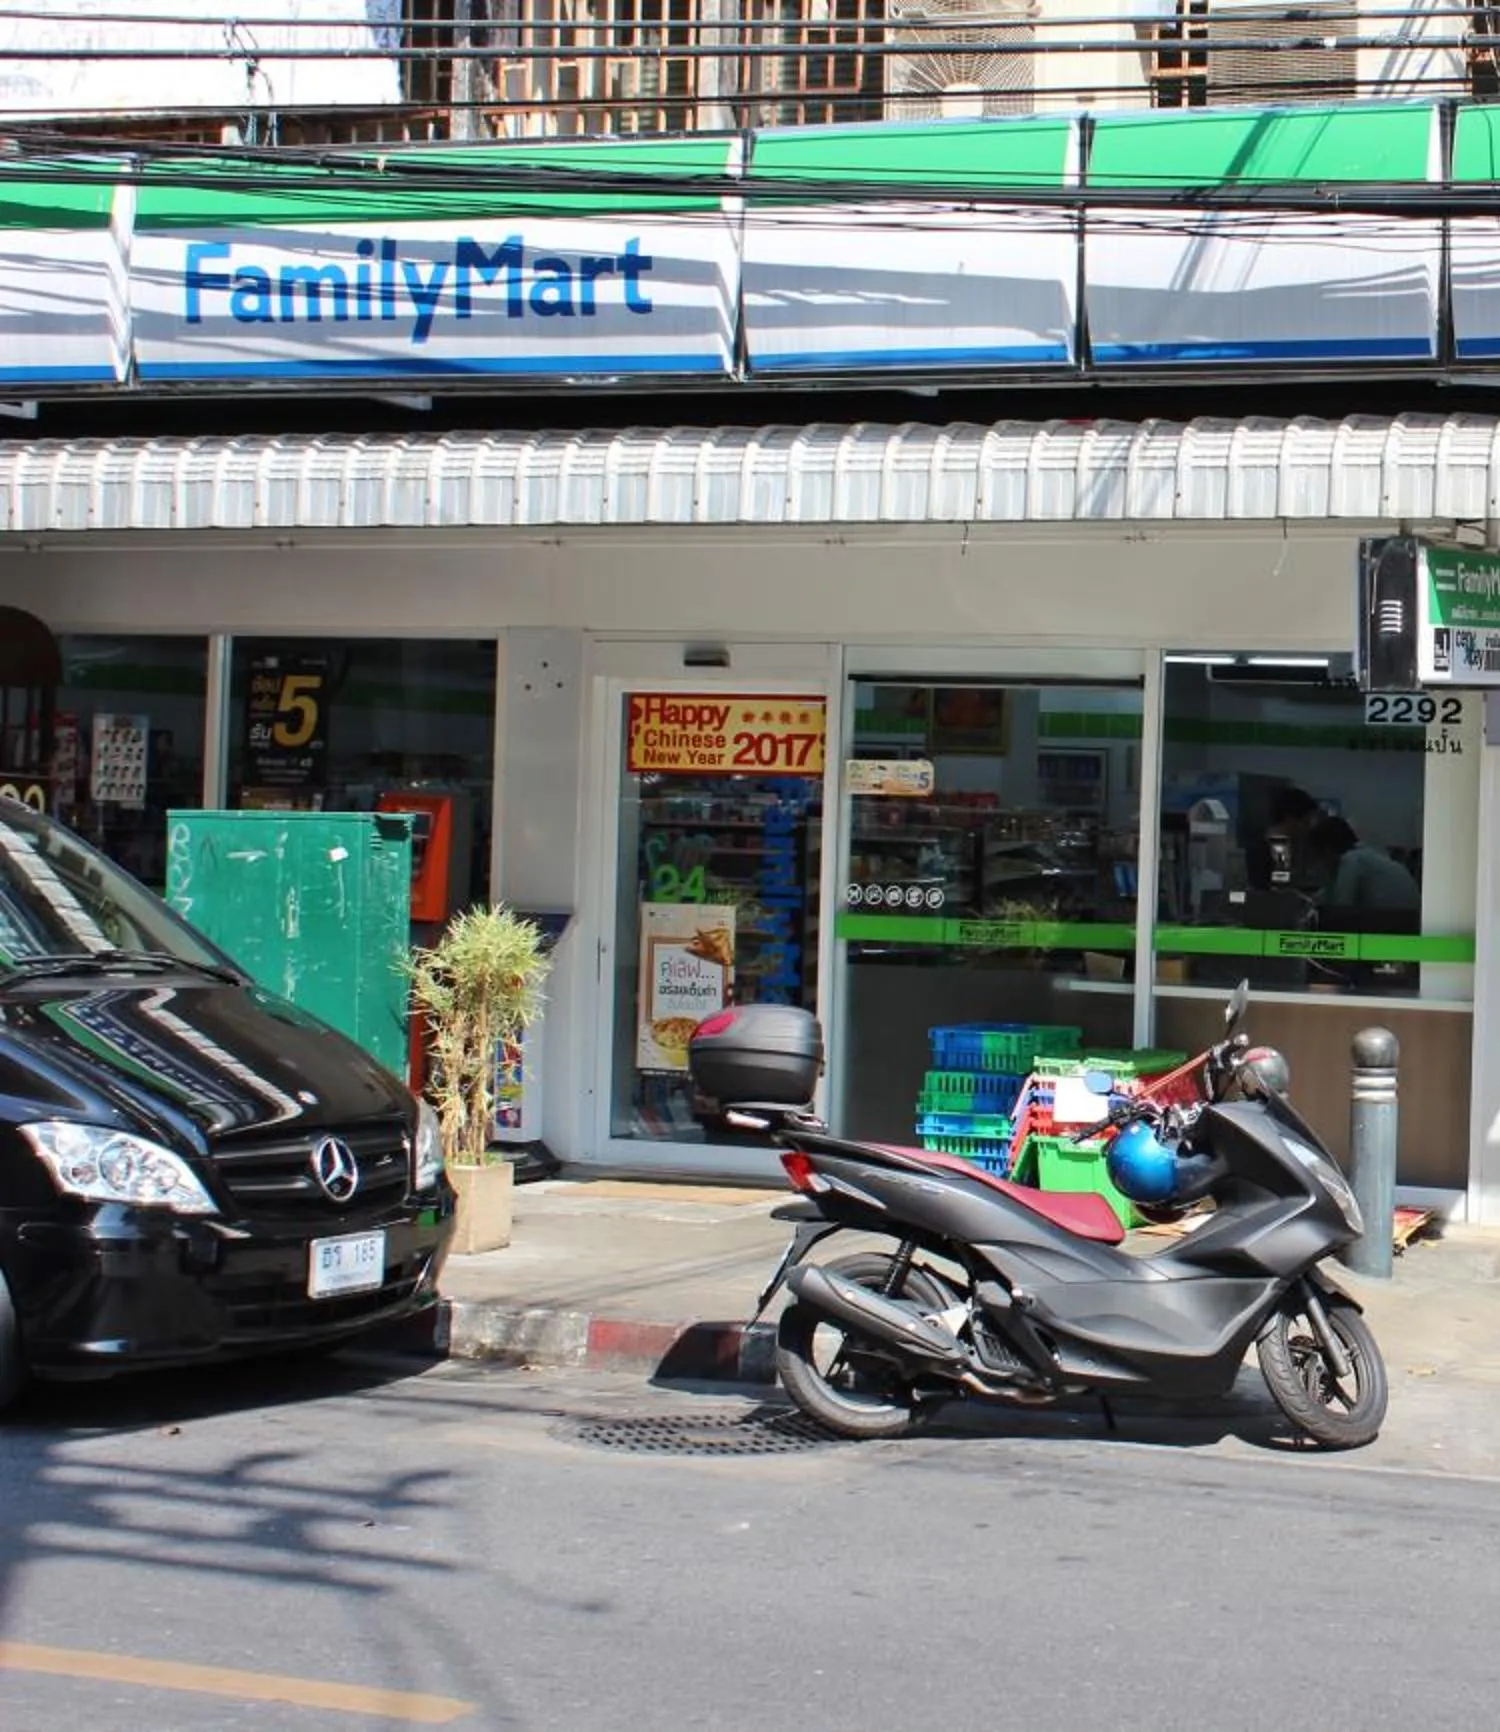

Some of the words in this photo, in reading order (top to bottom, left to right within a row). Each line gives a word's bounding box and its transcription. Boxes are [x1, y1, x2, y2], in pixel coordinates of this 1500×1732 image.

[185, 233, 653, 344] FamilyMart
[273, 674, 322, 747] 5
[644, 697, 730, 731] Happy
[1368, 697, 1462, 724] 2292
[644, 729, 726, 748] Chinese
[733, 732, 818, 767] 2017
[643, 750, 680, 765] New
[687, 750, 725, 765] Year
[655, 864, 706, 902] 24
[1280, 937, 1344, 953] FamilyMart
